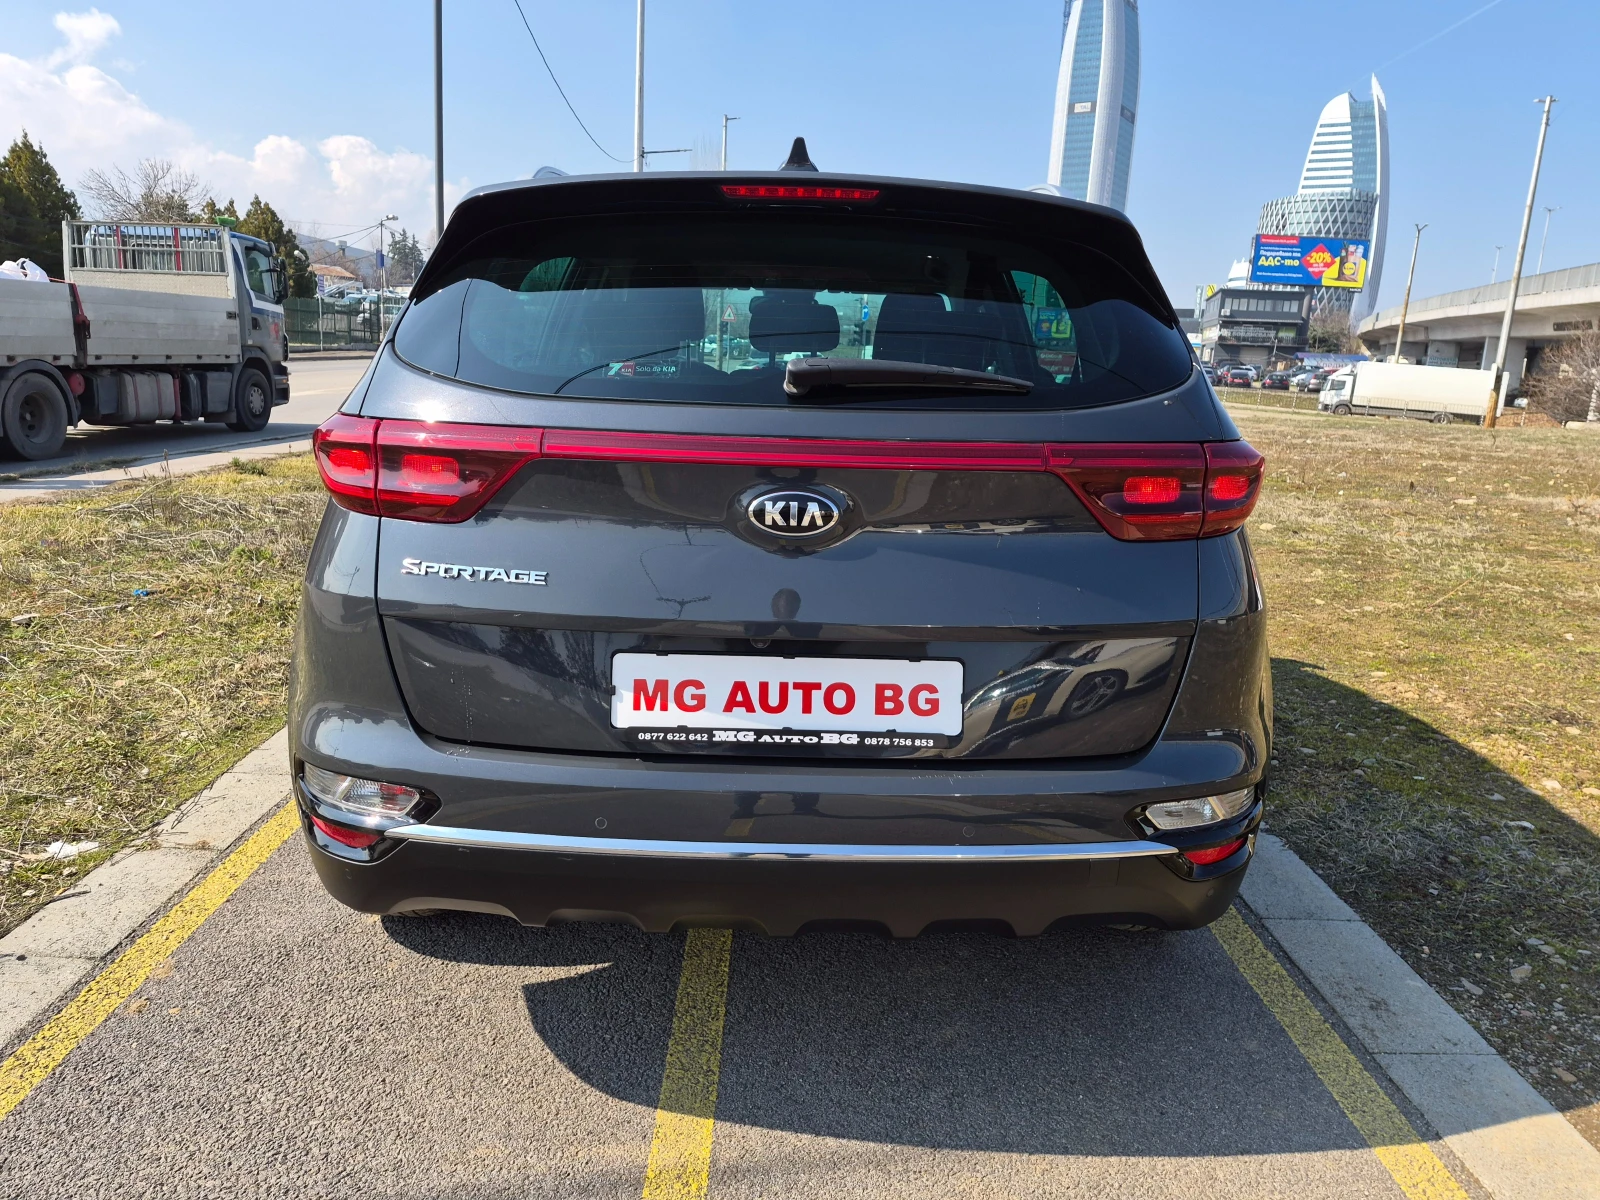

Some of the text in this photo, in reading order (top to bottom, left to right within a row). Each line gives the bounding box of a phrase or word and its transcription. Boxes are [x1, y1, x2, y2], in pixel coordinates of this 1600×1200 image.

[1306, 252, 1331, 264] -20%
[764, 501, 824, 526] KIA
[401, 558, 548, 585] SPORTAGE
[632, 678, 940, 717] MG AUTO BG
[638, 732, 664, 741] 0877
[667, 733, 686, 741] 622
[689, 733, 708, 741] 642
[713, 730, 757, 742] MG
[820, 733, 860, 744] BG
[864, 737, 890, 745] 0878
[893, 738, 912, 746] 756
[914, 739, 934, 747] 853
